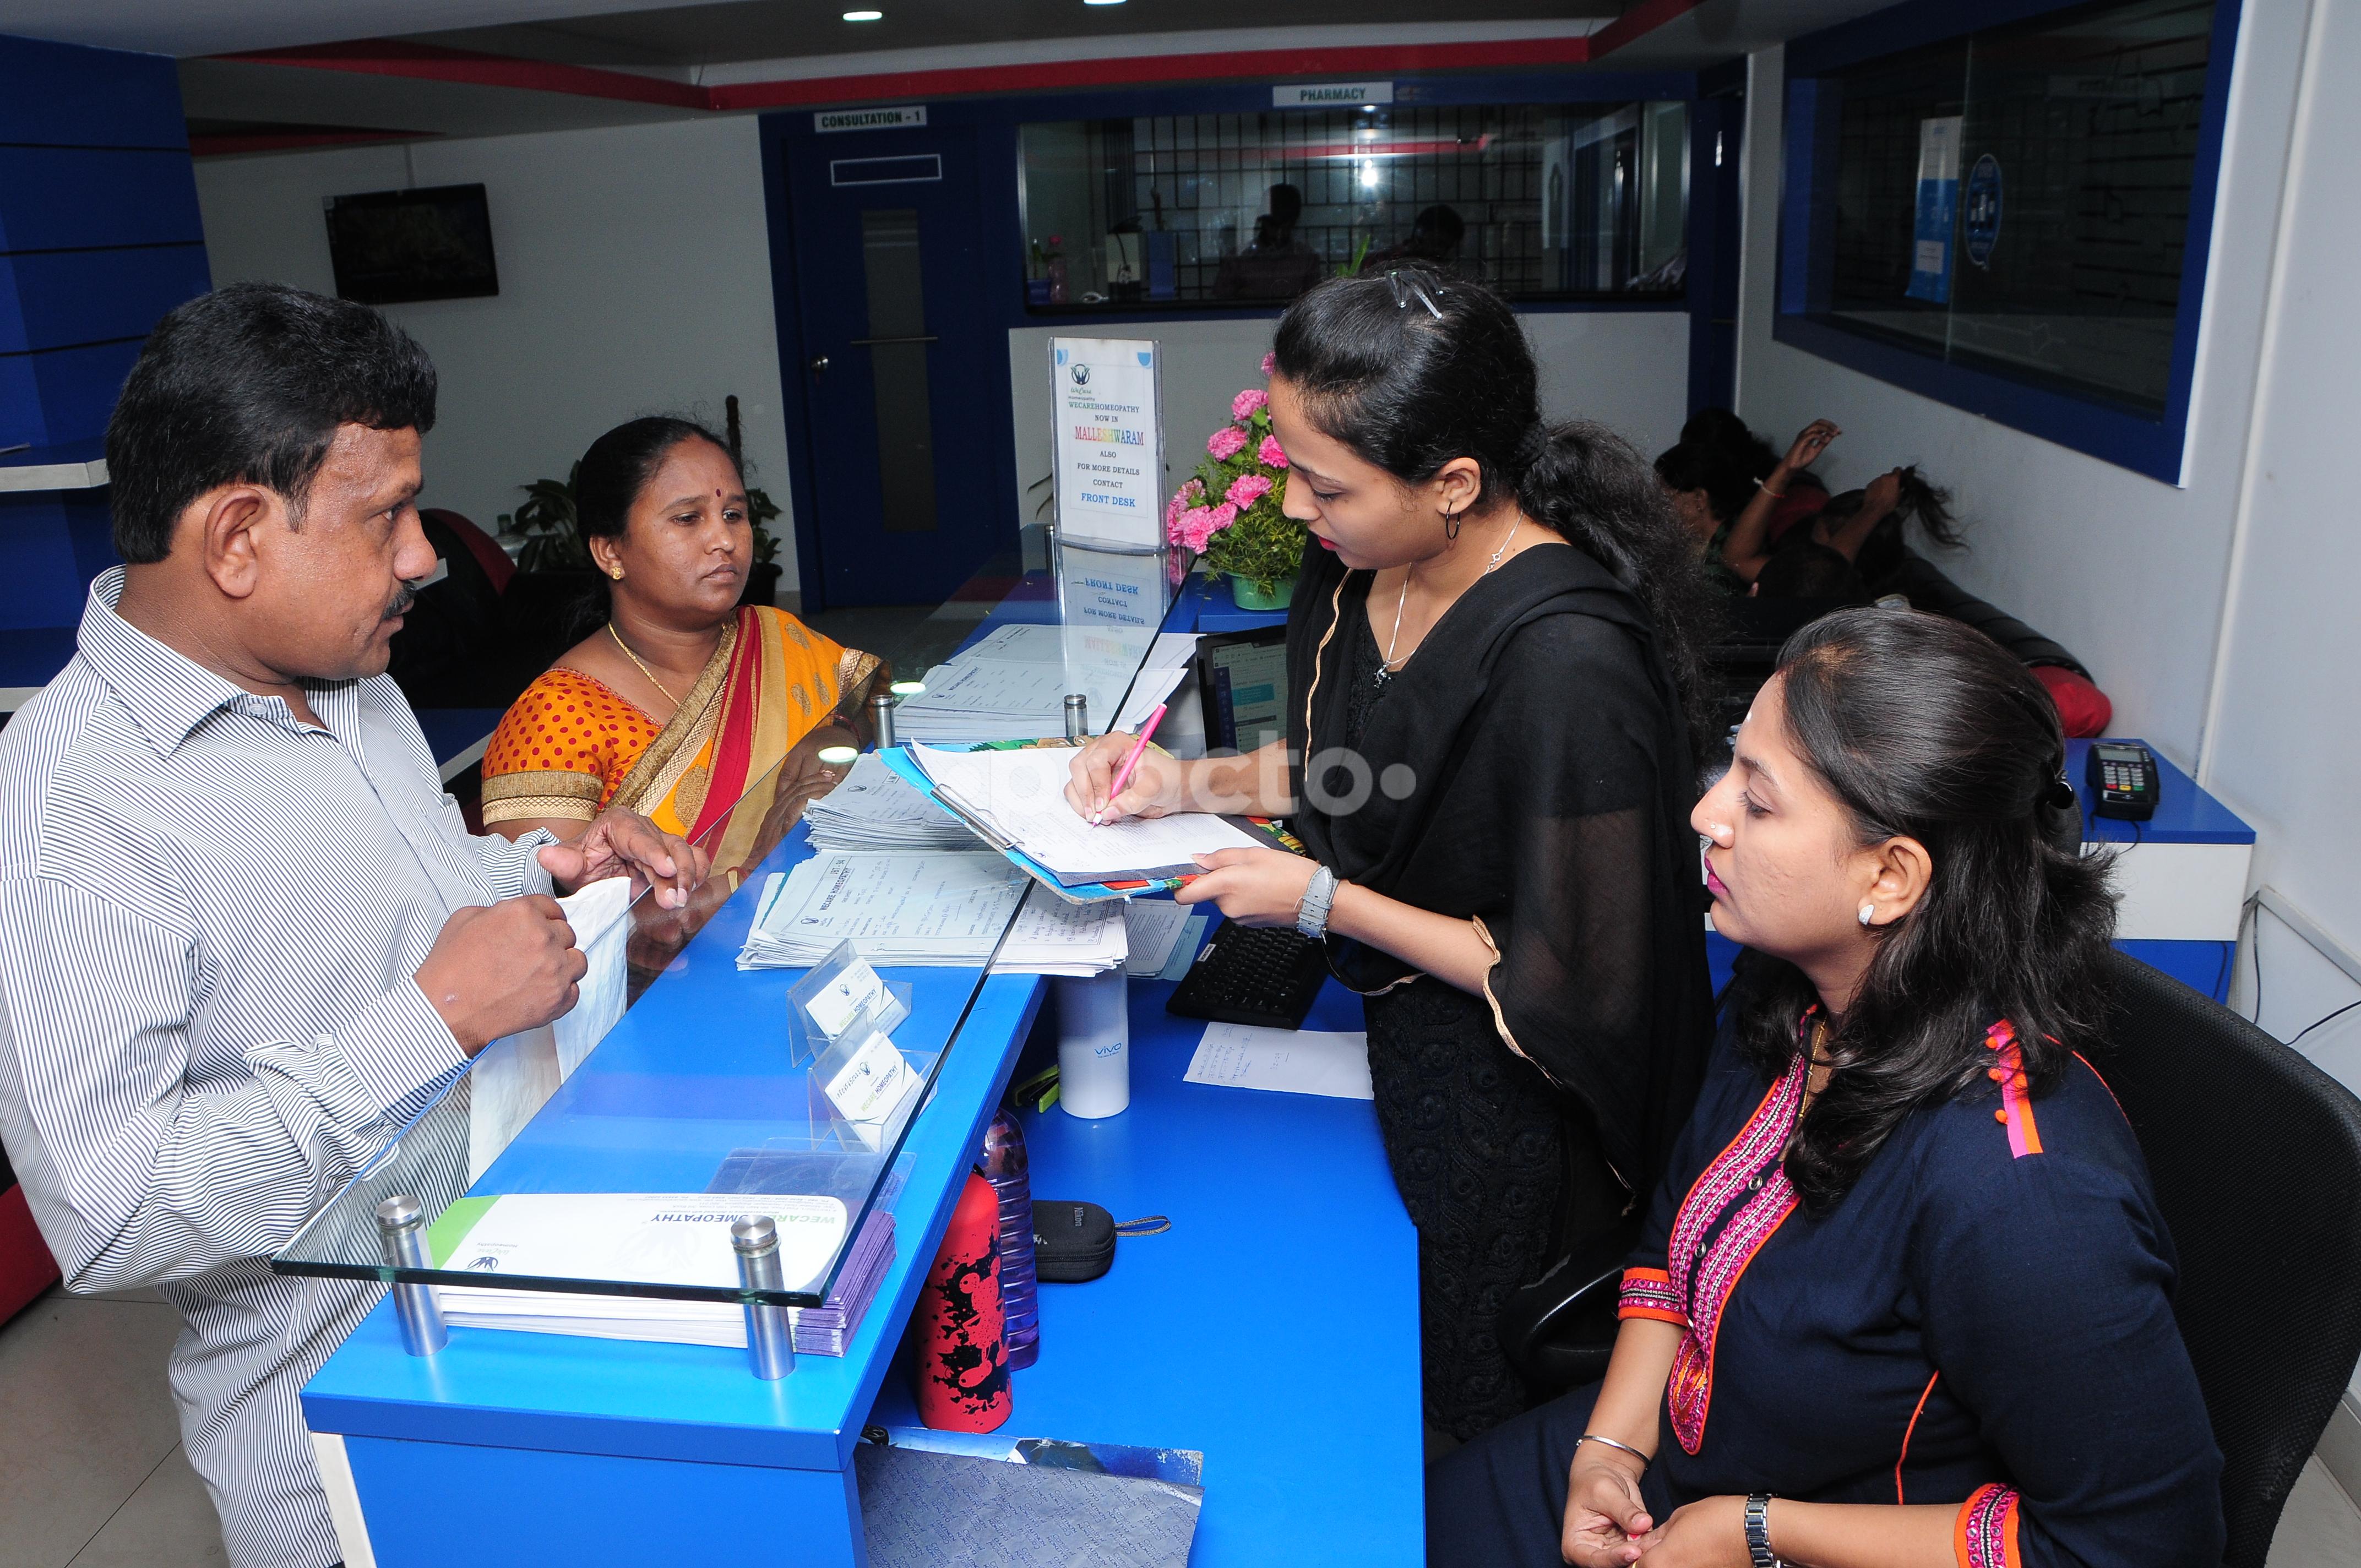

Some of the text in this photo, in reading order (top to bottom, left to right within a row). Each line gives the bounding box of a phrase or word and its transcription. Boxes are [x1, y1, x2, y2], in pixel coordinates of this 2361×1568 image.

[1300, 88, 1367, 100] PHARMACY
[822, 112, 902, 127] CONSULTATION
[915, 111, 920, 121] 1
[1069, 401, 1139, 413] WECAREHOMEOPATHY
[1075, 426, 1144, 445] MALLESHWARAM
[1092, 464, 1111, 472] MORE
[1113, 466, 1140, 475] DETAILS
[1093, 479, 1123, 488] CONTACT
[1081, 493, 1135, 507] FRONT DESK
[819, 894, 836, 911] WECARE
[830, 867, 852, 894] HOMEOPATHY
[853, 988, 877, 1014] HOMEOPATHY
[1094, 1043, 1122, 1054] vivo
[874, 1065, 898, 1095] HOMEOPATHY
[1074, 1207, 1083, 1227] Nikon
